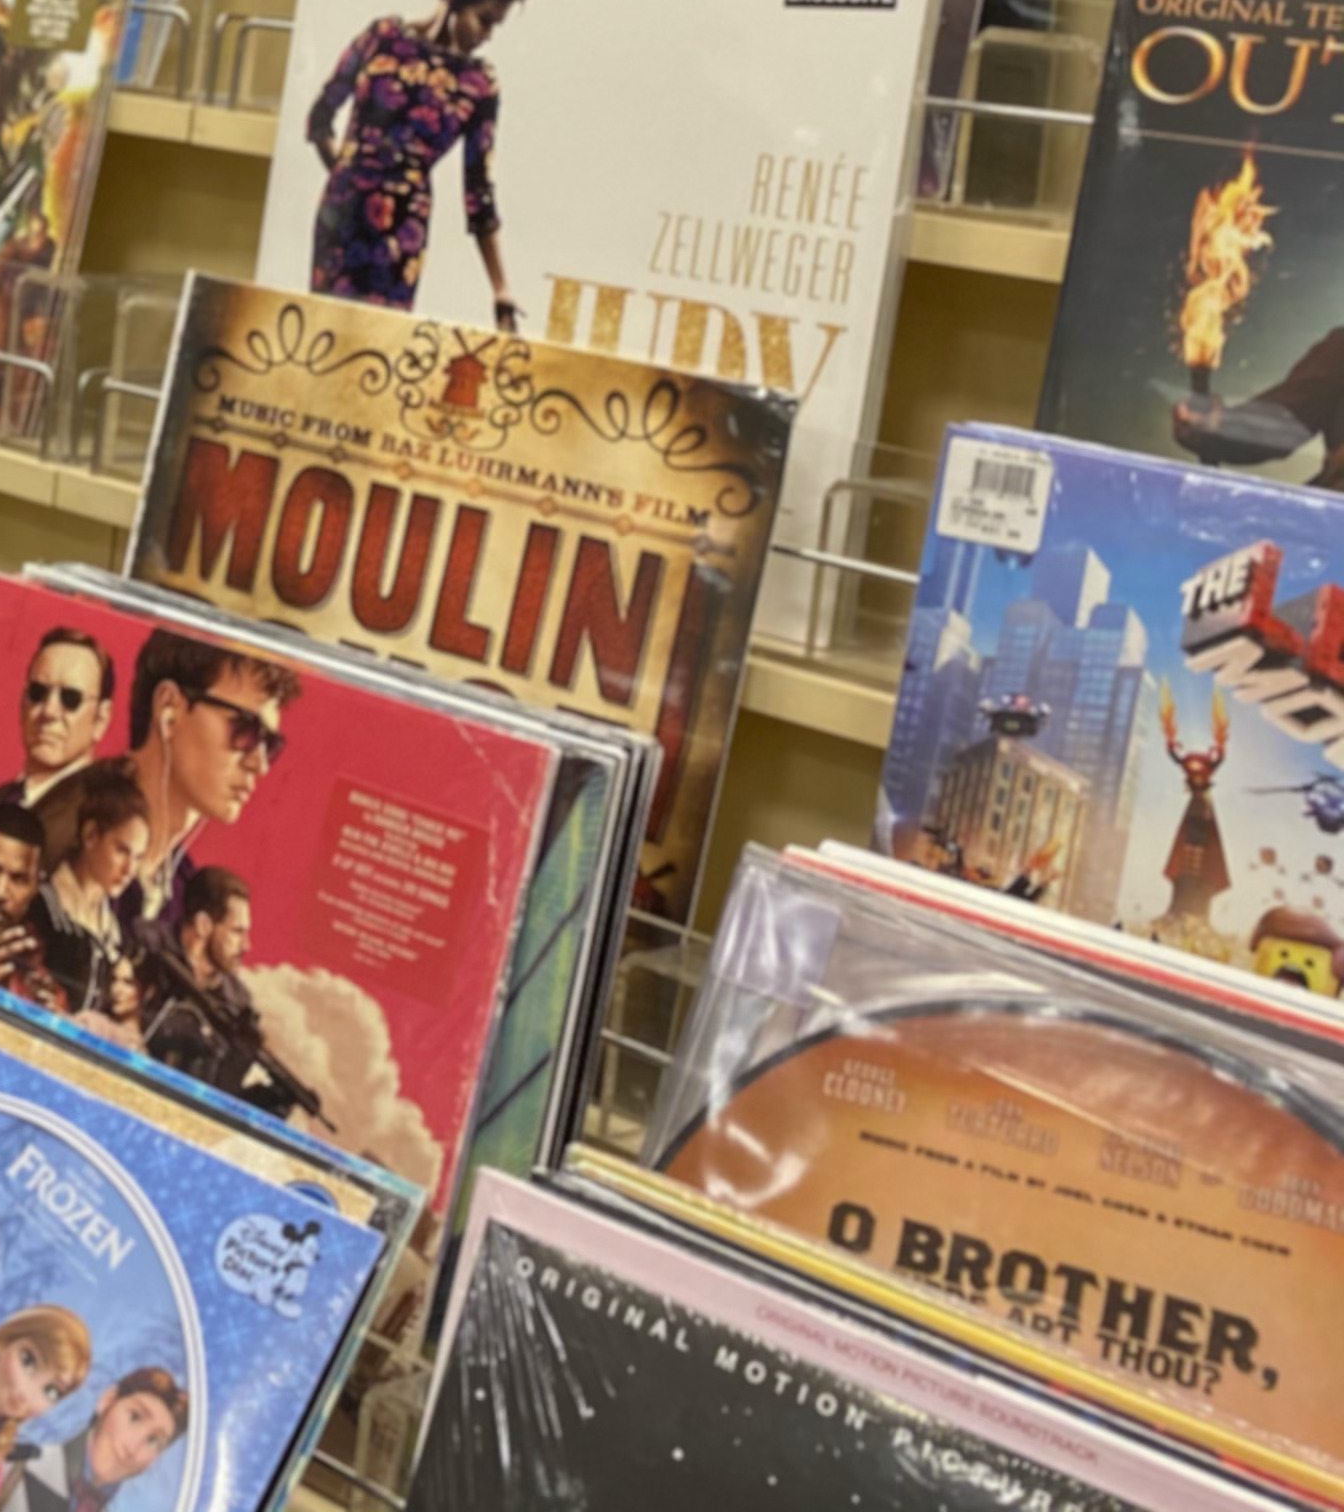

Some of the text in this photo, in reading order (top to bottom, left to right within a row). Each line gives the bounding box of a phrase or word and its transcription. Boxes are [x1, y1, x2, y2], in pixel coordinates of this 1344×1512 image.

[749, 151, 868, 231] RENÉE
[648, 210, 855, 305] ZELLWEGER
[217, 395, 296, 428] MUSIC
[301, 414, 372, 447] FROM
[381, 432, 432, 462] BAZ
[633, 492, 710, 529] FILM
[167, 437, 667, 708] MOULIN
[823, 1071, 907, 1114] CLOONEY
[915, 1145, 959, 1165] FROM
[6, 1142, 136, 1271] FROZEN
[1238, 1183, 1344, 1238] GOODMA
[224, 1235, 280, 1274] Picture
[828, 1200, 1278, 1391] O BROTHER,
[515, 1255, 690, 1353] ORIGINAL
[714, 1345, 867, 1431] MOTION
[756, 1303, 1098, 1463] ORIGINAL MOTION PICTURE SOUNDTRACK
[1097, 1333, 1223, 1396] THOU?
